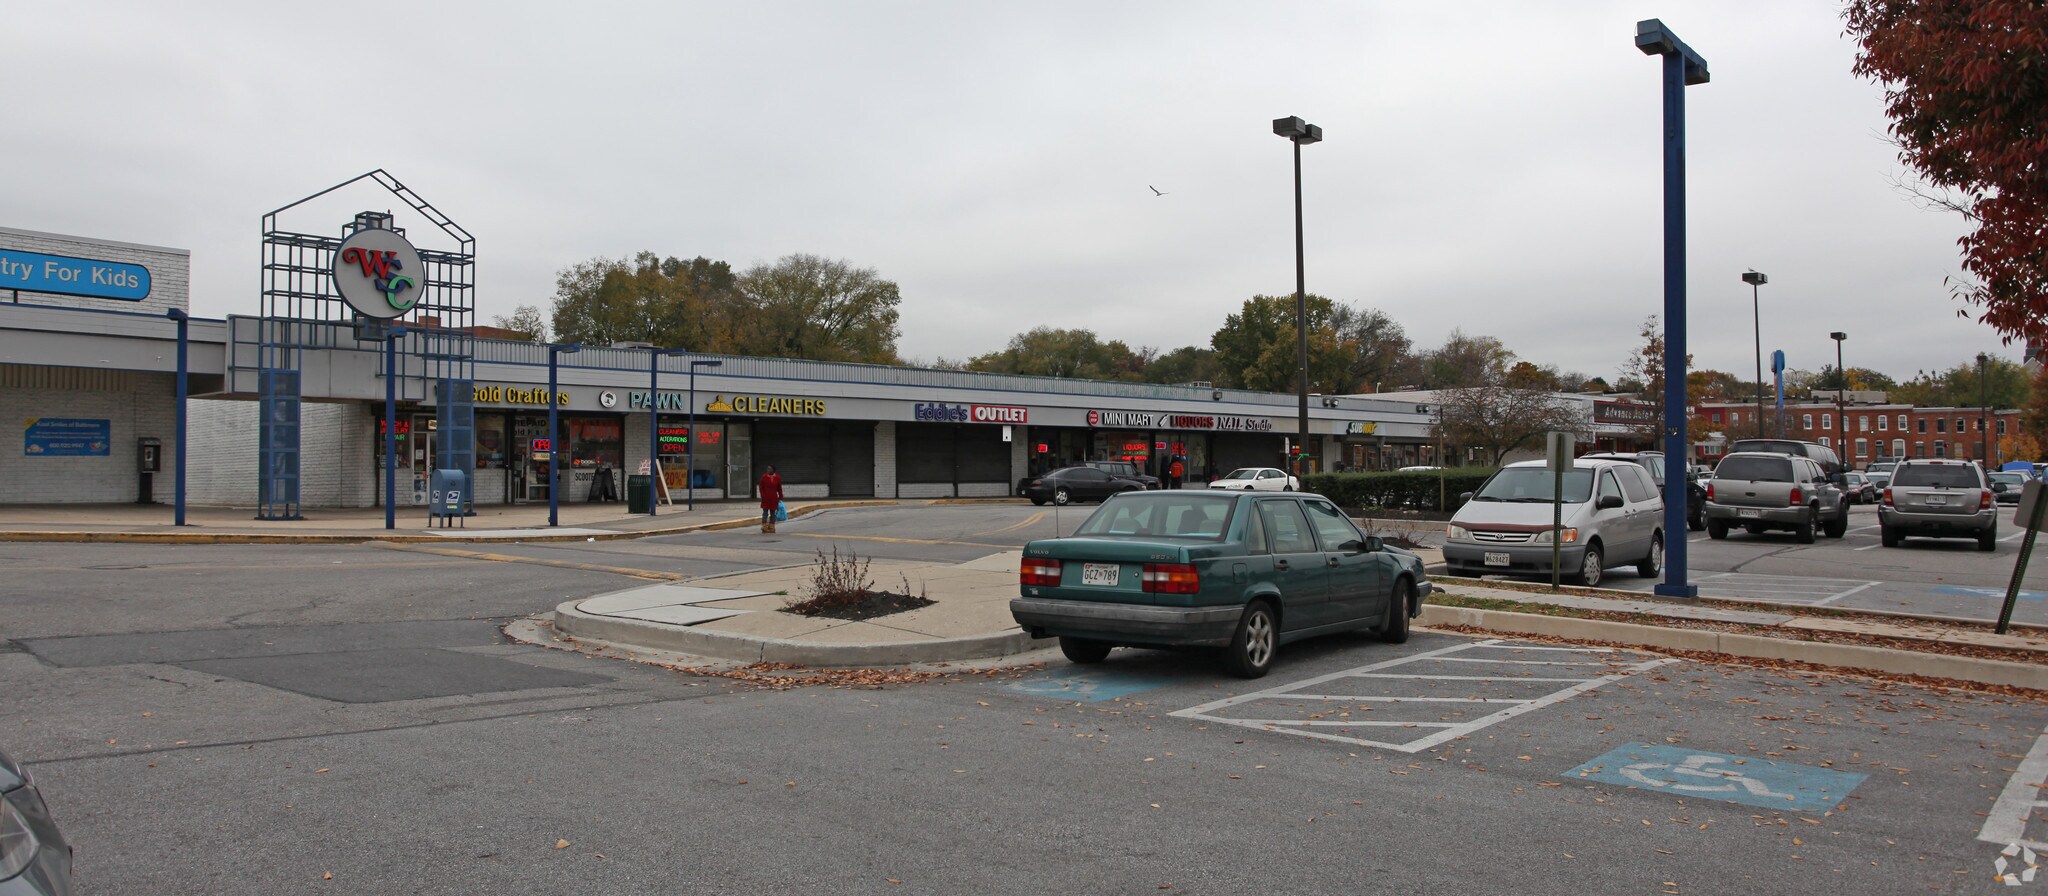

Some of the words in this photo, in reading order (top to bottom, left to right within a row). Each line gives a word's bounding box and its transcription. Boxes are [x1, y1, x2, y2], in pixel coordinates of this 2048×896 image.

[44, 261, 82, 283] For
[92, 266, 139, 288] Kids
[473, 385, 501, 402] Gold
[630, 391, 685, 410] PAWN
[734, 396, 826, 415] CLEANERS
[914, 403, 968, 421] Eddie's
[975, 406, 1026, 422] OUTLET
[1605, 406, 1631, 419] Advance
[1102, 412, 1124, 426] MINI
[1127, 413, 1154, 426] MART
[1171, 415, 1215, 428] LIQUORS
[1218, 416, 1243, 430] NAIL
[1246, 418, 1273, 431] Studio
[571, 418, 622, 441] PAWN
[1349, 422, 1377, 434] SUBWAY
[662, 443, 685, 452] OPEN
[1122, 443, 1147, 451] LIQUORS
[1084, 569, 1098, 581] GCZ
[1103, 570, 1117, 581] 789
